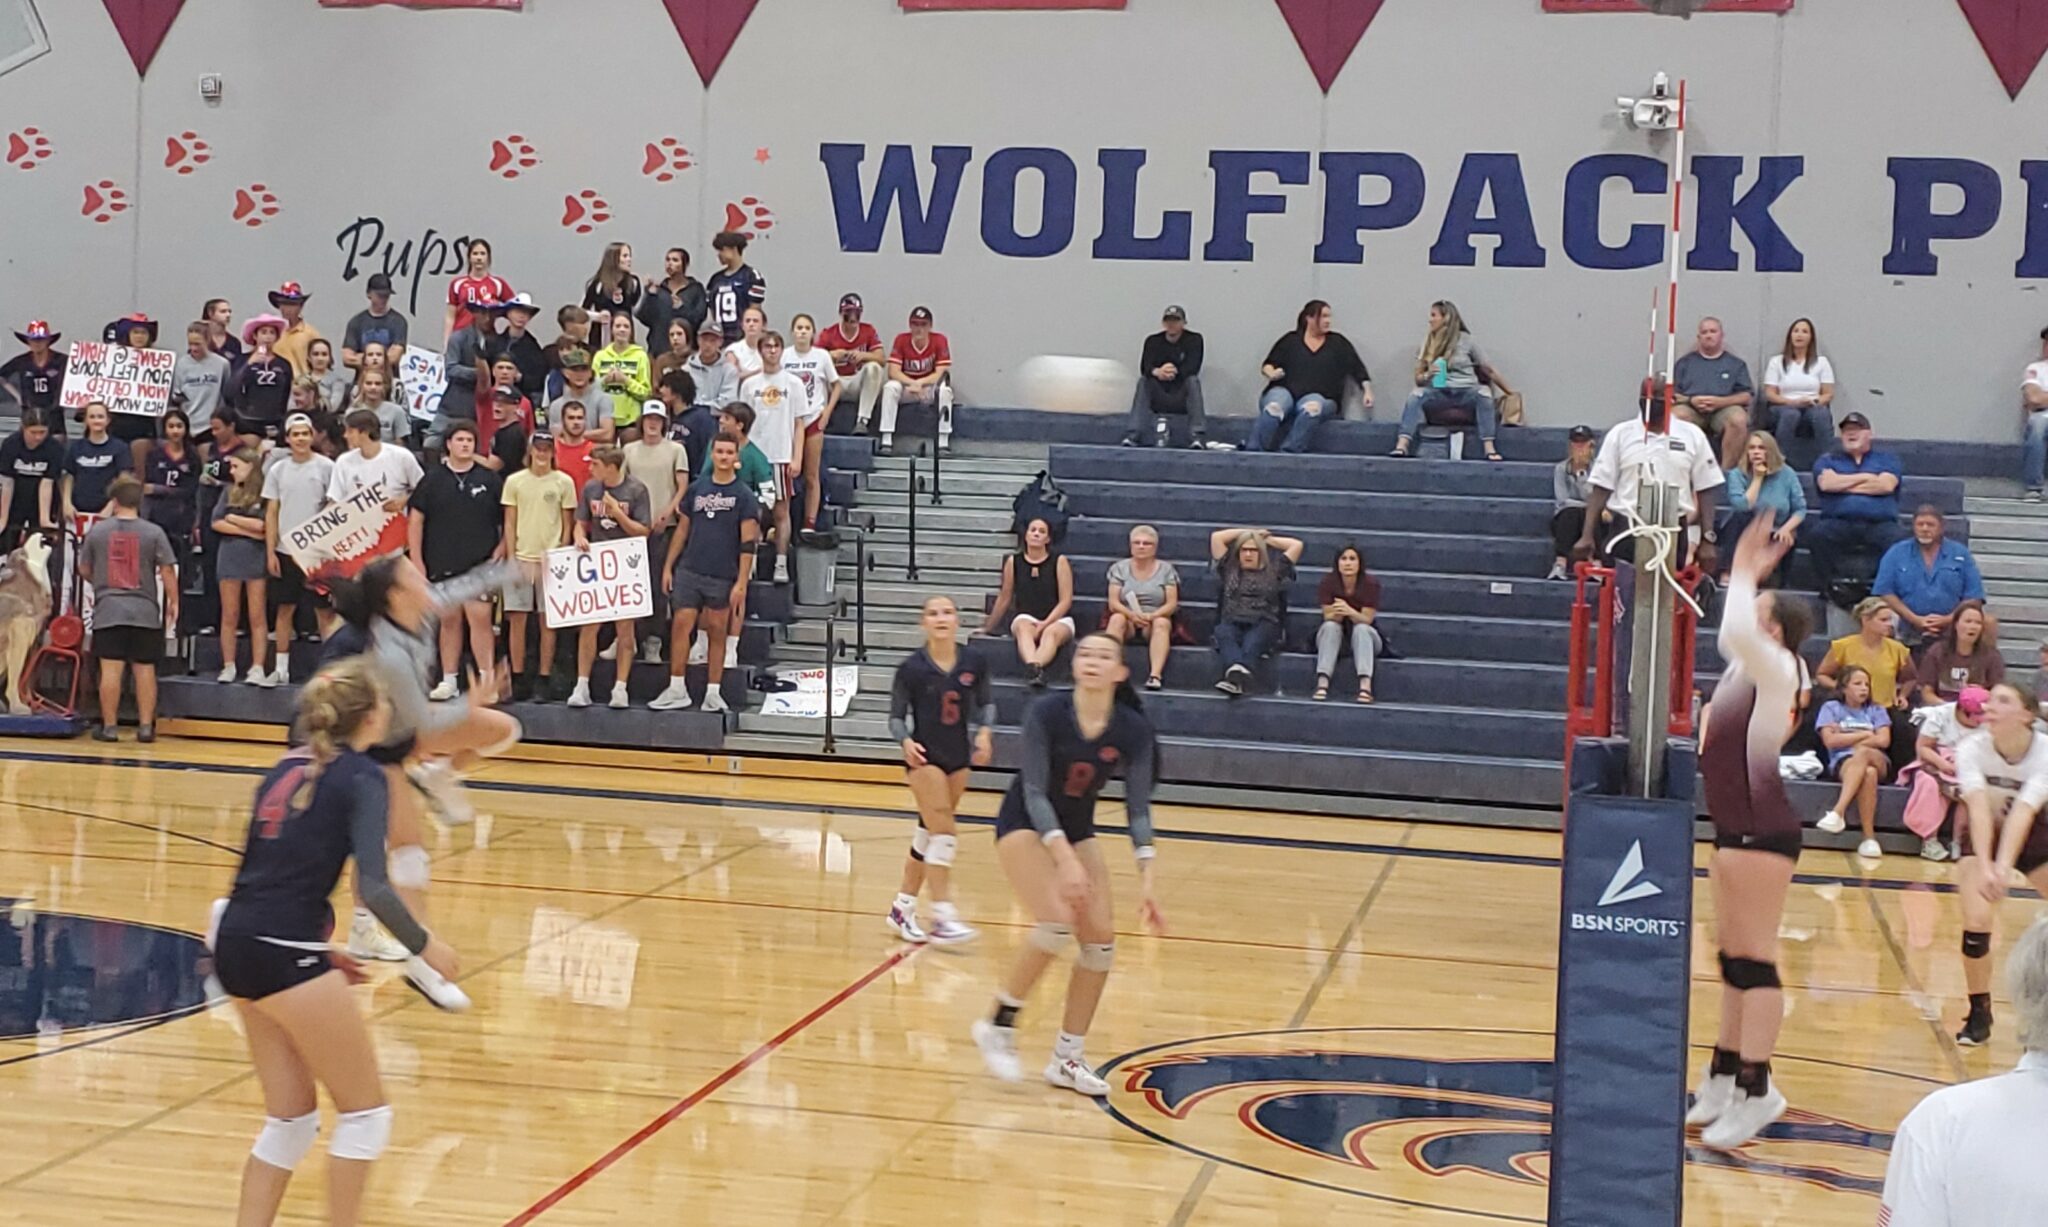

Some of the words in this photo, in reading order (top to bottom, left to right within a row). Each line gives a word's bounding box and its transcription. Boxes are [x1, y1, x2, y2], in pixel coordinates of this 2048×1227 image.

[820, 143, 1804, 272] WOLFPACK
[1882, 157, 2048, 278] P
[336, 216, 470, 318] Pups
[715, 291, 737, 323] 19
[71, 340, 108, 362] HOME
[133, 349, 172, 368] GAME
[70, 358, 107, 377] YOUR
[108, 363, 139, 381] LEFT
[142, 368, 172, 385] YOU
[33, 377, 48, 393] 16
[87, 377, 131, 396] CALLED
[257, 370, 276, 386] 22
[138, 383, 168, 399] MOM
[291, 506, 349, 550] BRING
[347, 482, 389, 513] THE
[577, 549, 619, 584] GO
[550, 583, 644, 619] WOLVES
[941, 690, 960, 726] 6
